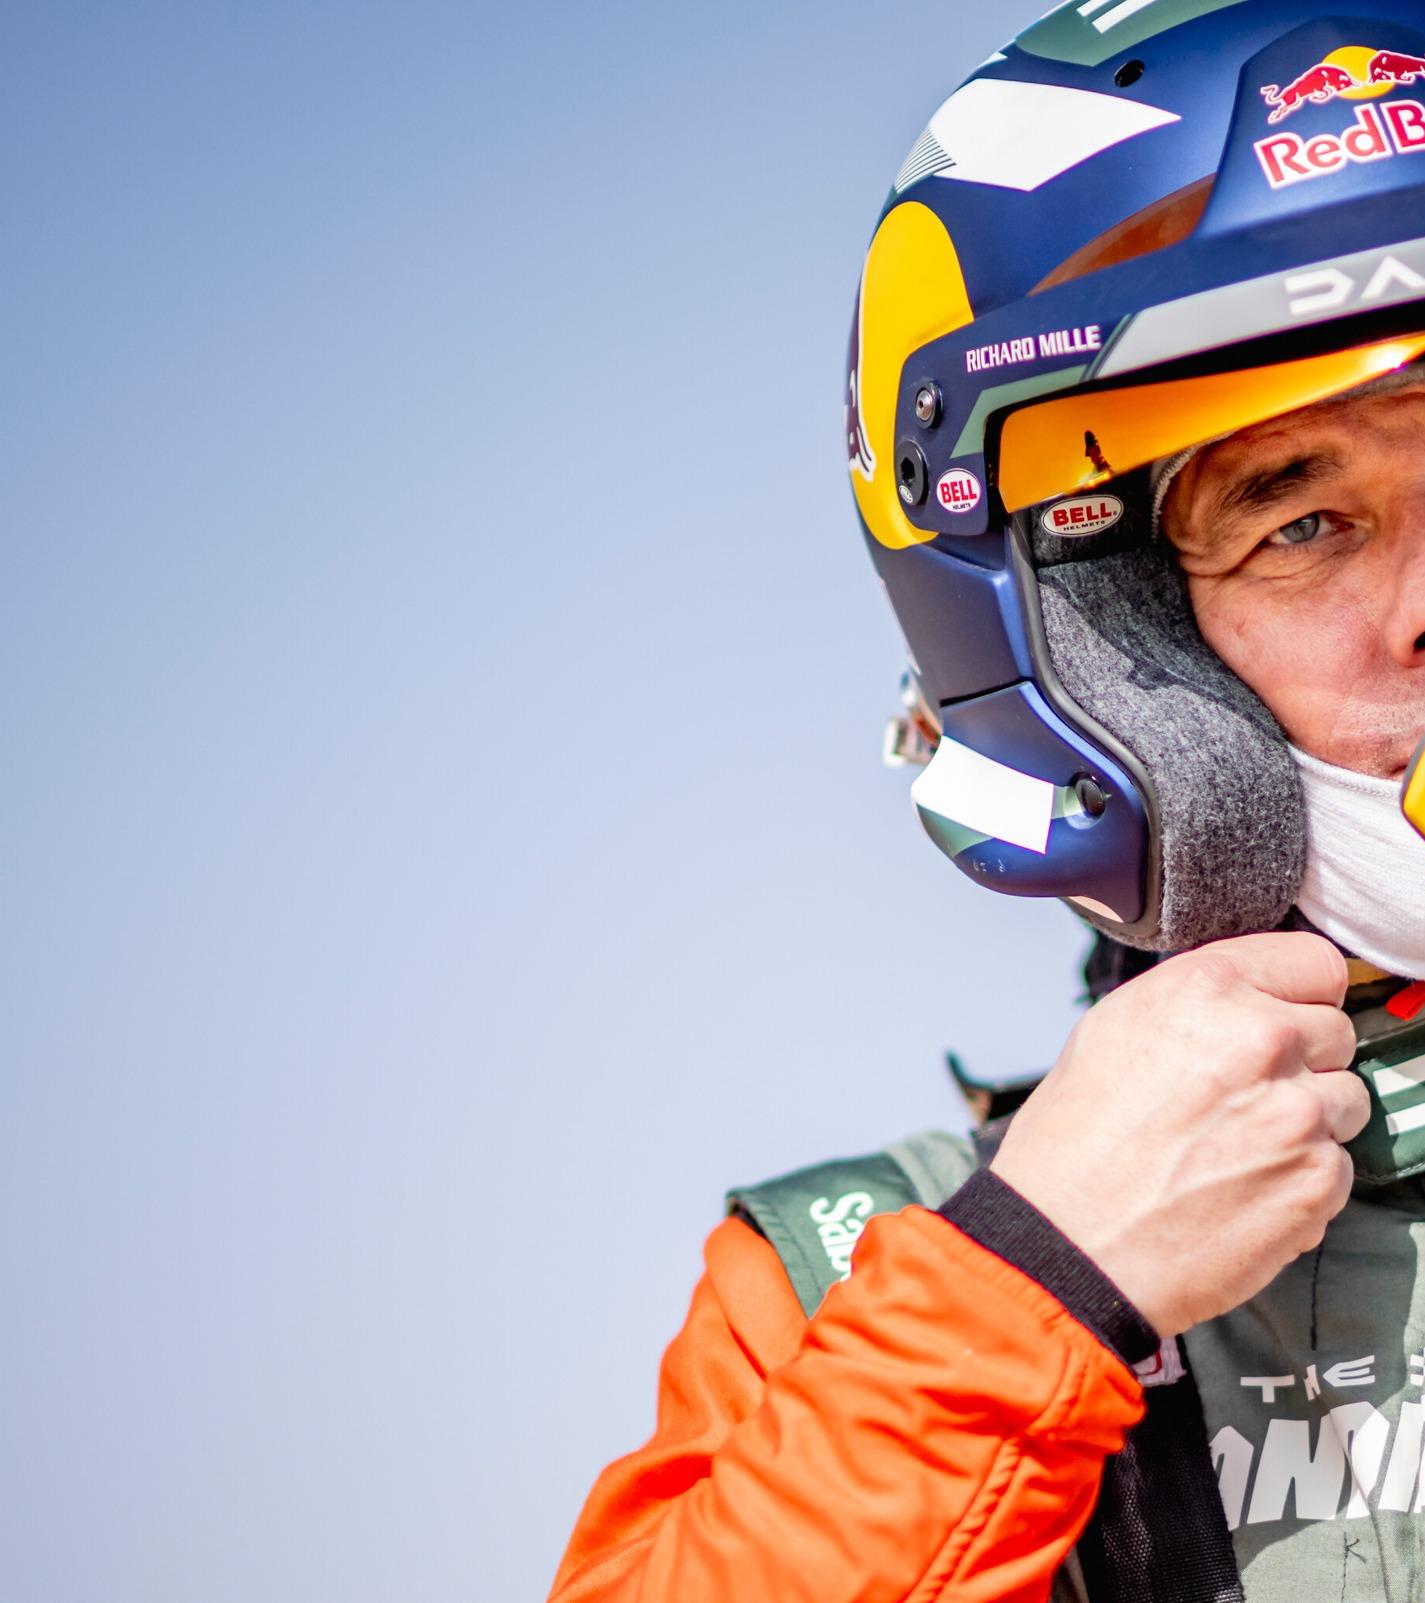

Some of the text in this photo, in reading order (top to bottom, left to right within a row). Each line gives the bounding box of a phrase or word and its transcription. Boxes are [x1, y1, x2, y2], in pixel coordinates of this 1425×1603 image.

[1256, 105, 1390, 186] Red
[965, 324, 1102, 373] RICHARD MILLE
[940, 479, 977, 504] BELL
[1052, 502, 1112, 527] BELL
[1063, 520, 1106, 532] HELMETS
